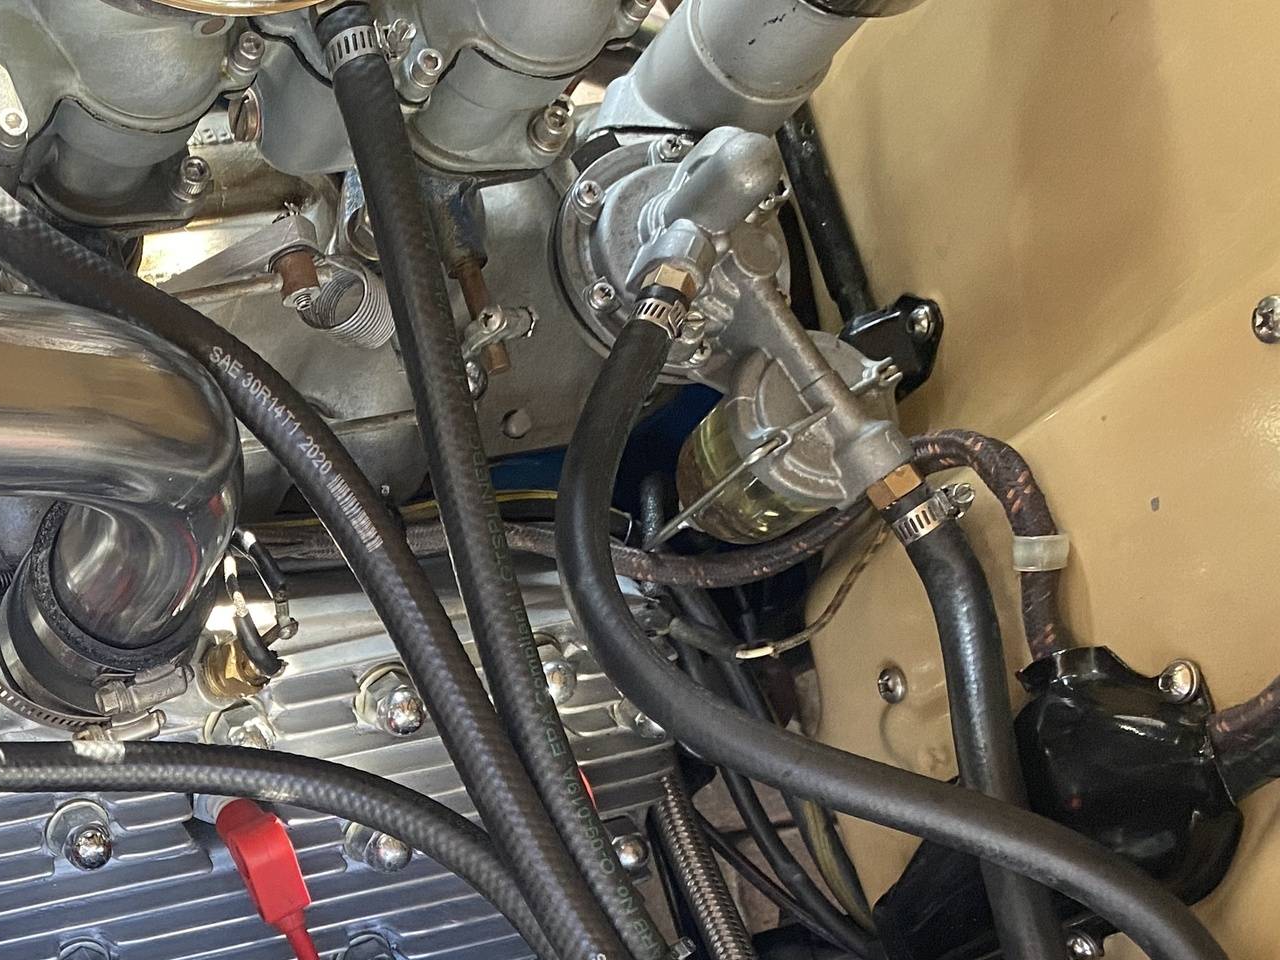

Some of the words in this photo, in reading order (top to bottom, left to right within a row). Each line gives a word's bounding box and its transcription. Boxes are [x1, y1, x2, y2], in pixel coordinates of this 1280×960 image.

[209, 346, 243, 379] SAE
[241, 373, 301, 436] 30R14T1
[298, 436, 333, 476] 2020
[511, 603, 551, 706] Compliant
[538, 709, 566, 758] EPA
